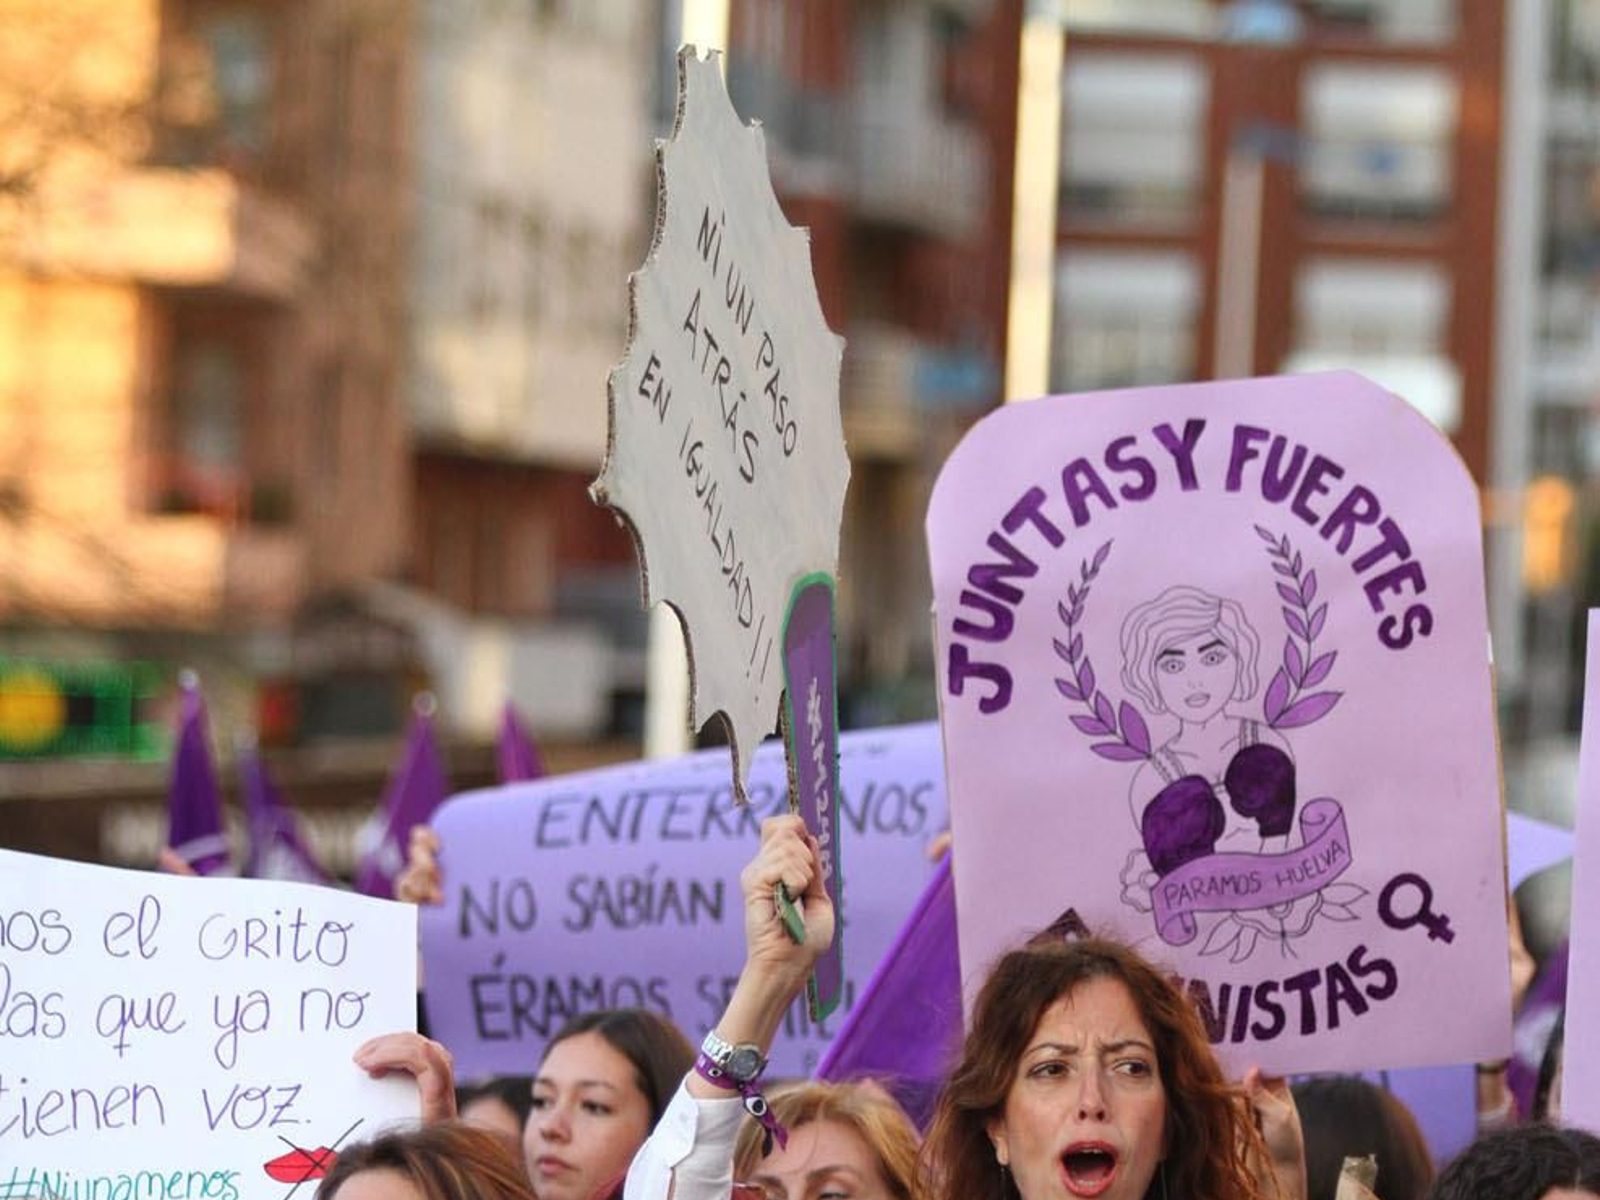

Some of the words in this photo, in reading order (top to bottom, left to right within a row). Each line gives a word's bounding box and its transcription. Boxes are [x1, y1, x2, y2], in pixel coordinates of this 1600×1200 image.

[638, 350, 672, 423] EN
[683, 288, 758, 484] ATRÁS
[725, 262, 755, 336] UN
[756, 330, 798, 457] PASO
[1225, 423, 1434, 651] FUERTES
[459, 872, 537, 939] NO
[563, 861, 726, 933] SABÍAN
[1163, 871, 1262, 909] PARAMOS
[1275, 839, 1346, 889] HUELVA
[0, 908, 72, 956] os
[103, 894, 161, 960] el
[96, 990, 186, 1058] que
[213, 989, 271, 1070] ya
[299, 986, 371, 1032] no
[1172, 944, 1398, 1044] NISTAS
